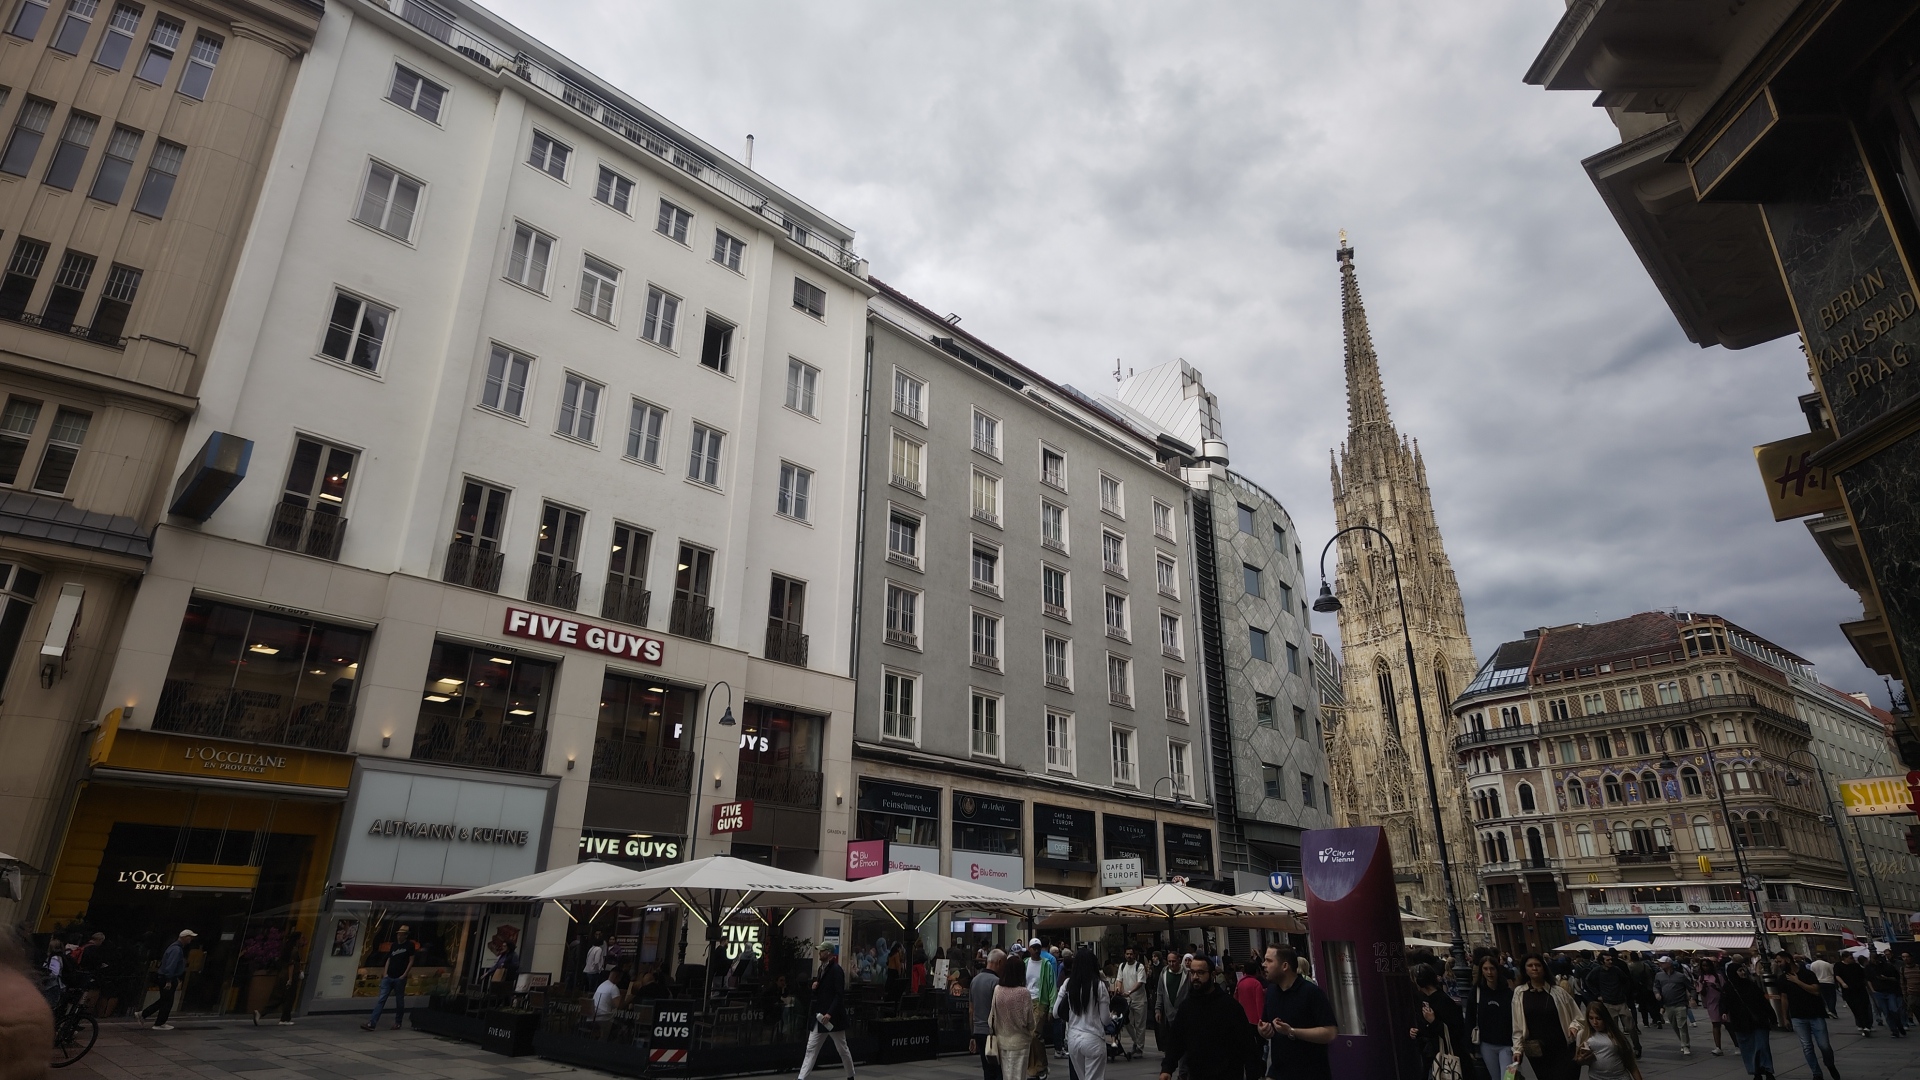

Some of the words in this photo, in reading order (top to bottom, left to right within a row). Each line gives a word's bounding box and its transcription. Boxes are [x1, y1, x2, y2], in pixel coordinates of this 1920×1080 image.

[1819, 266, 1887, 332] BERLIN
[1815, 291, 1916, 376] KARLSBAD
[1847, 342, 1910, 398] PRAG
[1775, 451, 1828, 499] H&
[288, 608, 310, 616] GUYS
[508, 610, 579, 645] FIVE
[584, 627, 661, 662] GUYS
[185, 746, 287, 769] L'OCCITANE
[219, 763, 266, 773] PROVENCE
[721, 804, 742, 817] FIVE
[882, 799, 931, 813] Feinschmecker
[1855, 804, 1902, 812] COIF
[368, 819, 457, 840] ALTMANN
[459, 827, 469, 840] &
[717, 816, 743, 830] GUYS
[625, 839, 678, 859] GUYS
[1055, 844, 1073, 853] COFFEE
[1120, 851, 1140, 859] TEAROOM
[860, 851, 869, 860] Blu
[1175, 857, 1199, 866] RESTAURANT
[889, 861, 899, 869] Blu
[1106, 863, 1123, 871] CAFÉ
[980, 868, 988, 877] Blu
[1103, 871, 1139, 880] L'EUROPE
[1270, 875, 1283, 890] U
[1286, 875, 1293, 890] U
[721, 925, 760, 942] FIVE
[1578, 923, 1614, 933] Change
[1616, 922, 1648, 932] Money
[726, 942, 763, 960] UYS
[1373, 942, 1387, 956] 12
[1375, 958, 1389, 972] 12
[845, 1007, 854, 1015] YS
[955, 1001, 969, 1009] FIVE
[659, 1011, 688, 1023] FIVE
[719, 1013, 739, 1022] FIVE
[741, 1011, 764, 1021] GUYS
[488, 1026, 498, 1037] FIVE
[498, 1028, 511, 1039] GUYS
[654, 1025, 689, 1038] GUYS
[891, 1037, 908, 1047] FIVE
[910, 1035, 930, 1045] GUYS
